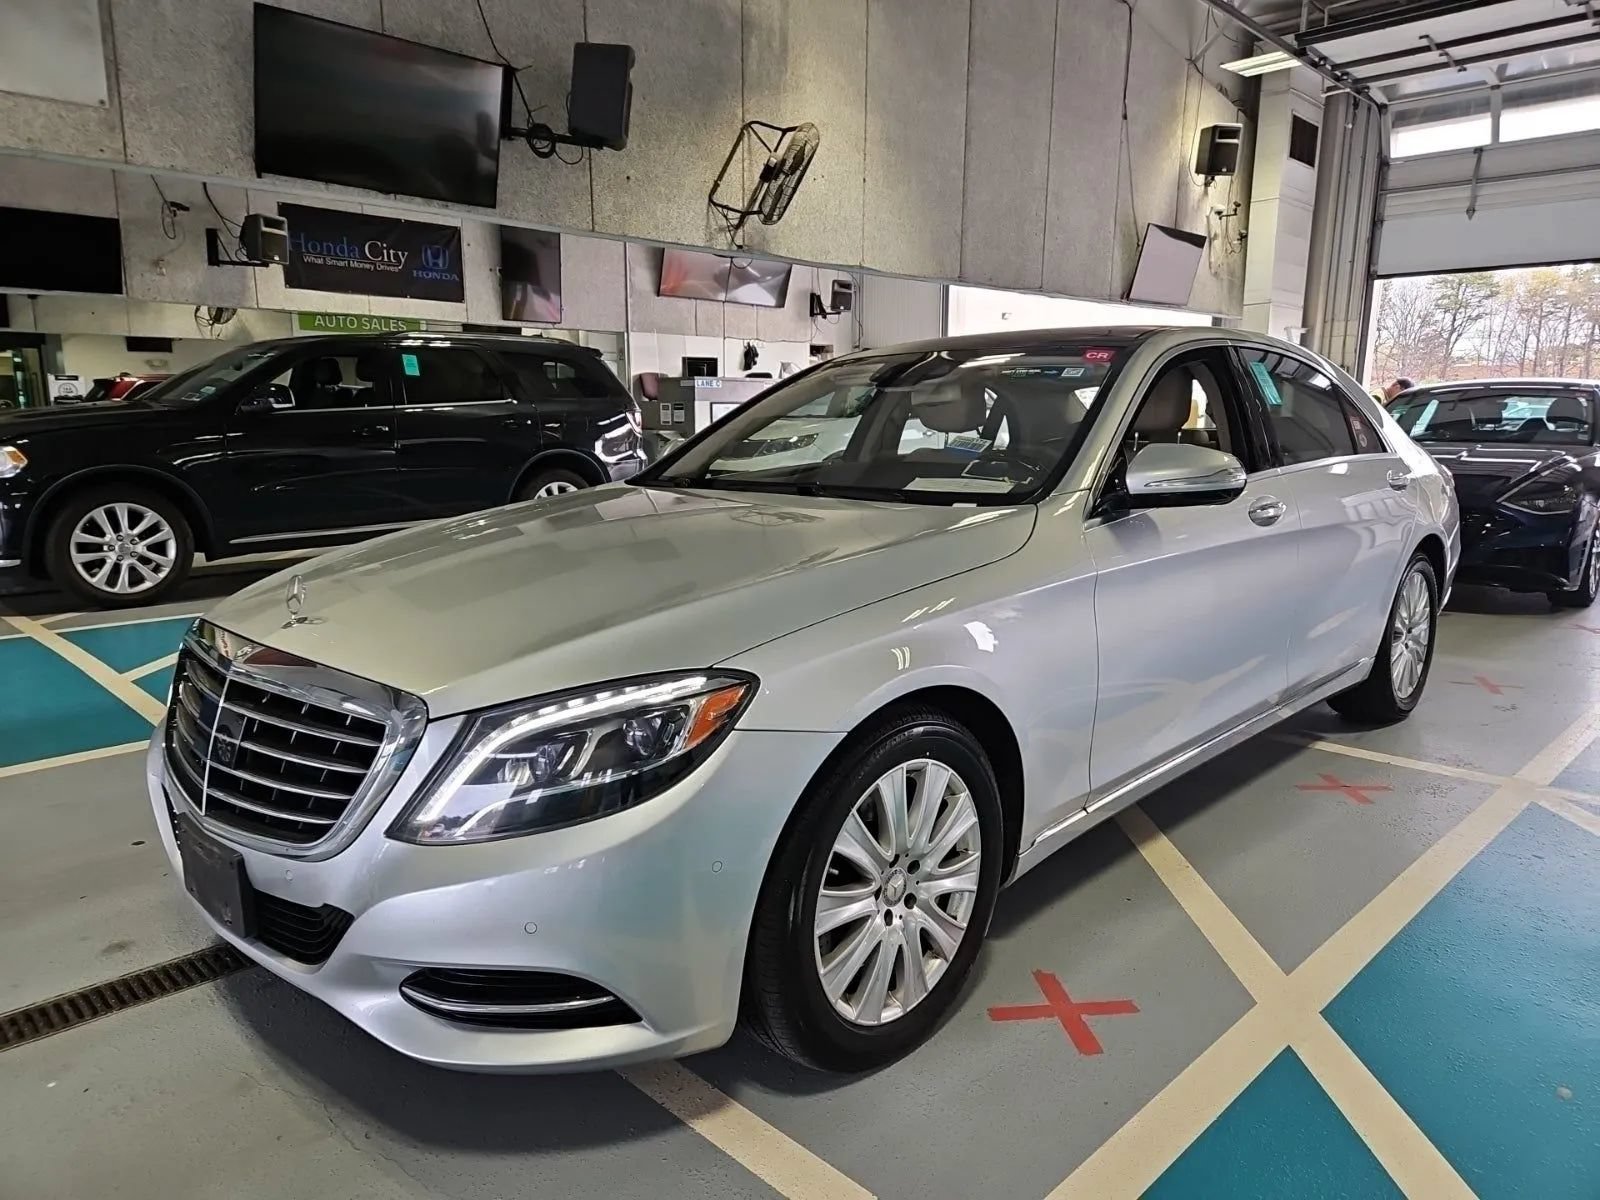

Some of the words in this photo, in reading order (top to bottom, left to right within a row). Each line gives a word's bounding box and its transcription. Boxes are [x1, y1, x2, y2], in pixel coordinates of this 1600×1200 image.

[289, 232, 359, 258] Honda
[364, 240, 408, 269] City
[303, 255, 324, 265] What
[326, 257, 348, 267] Smart
[350, 260, 374, 271] Money
[376, 262, 399, 272] Drives
[413, 269, 459, 281] HONDA
[314, 315, 358, 330] AUTO
[361, 317, 407, 332] SALES
[696, 379, 714, 387] LANE
